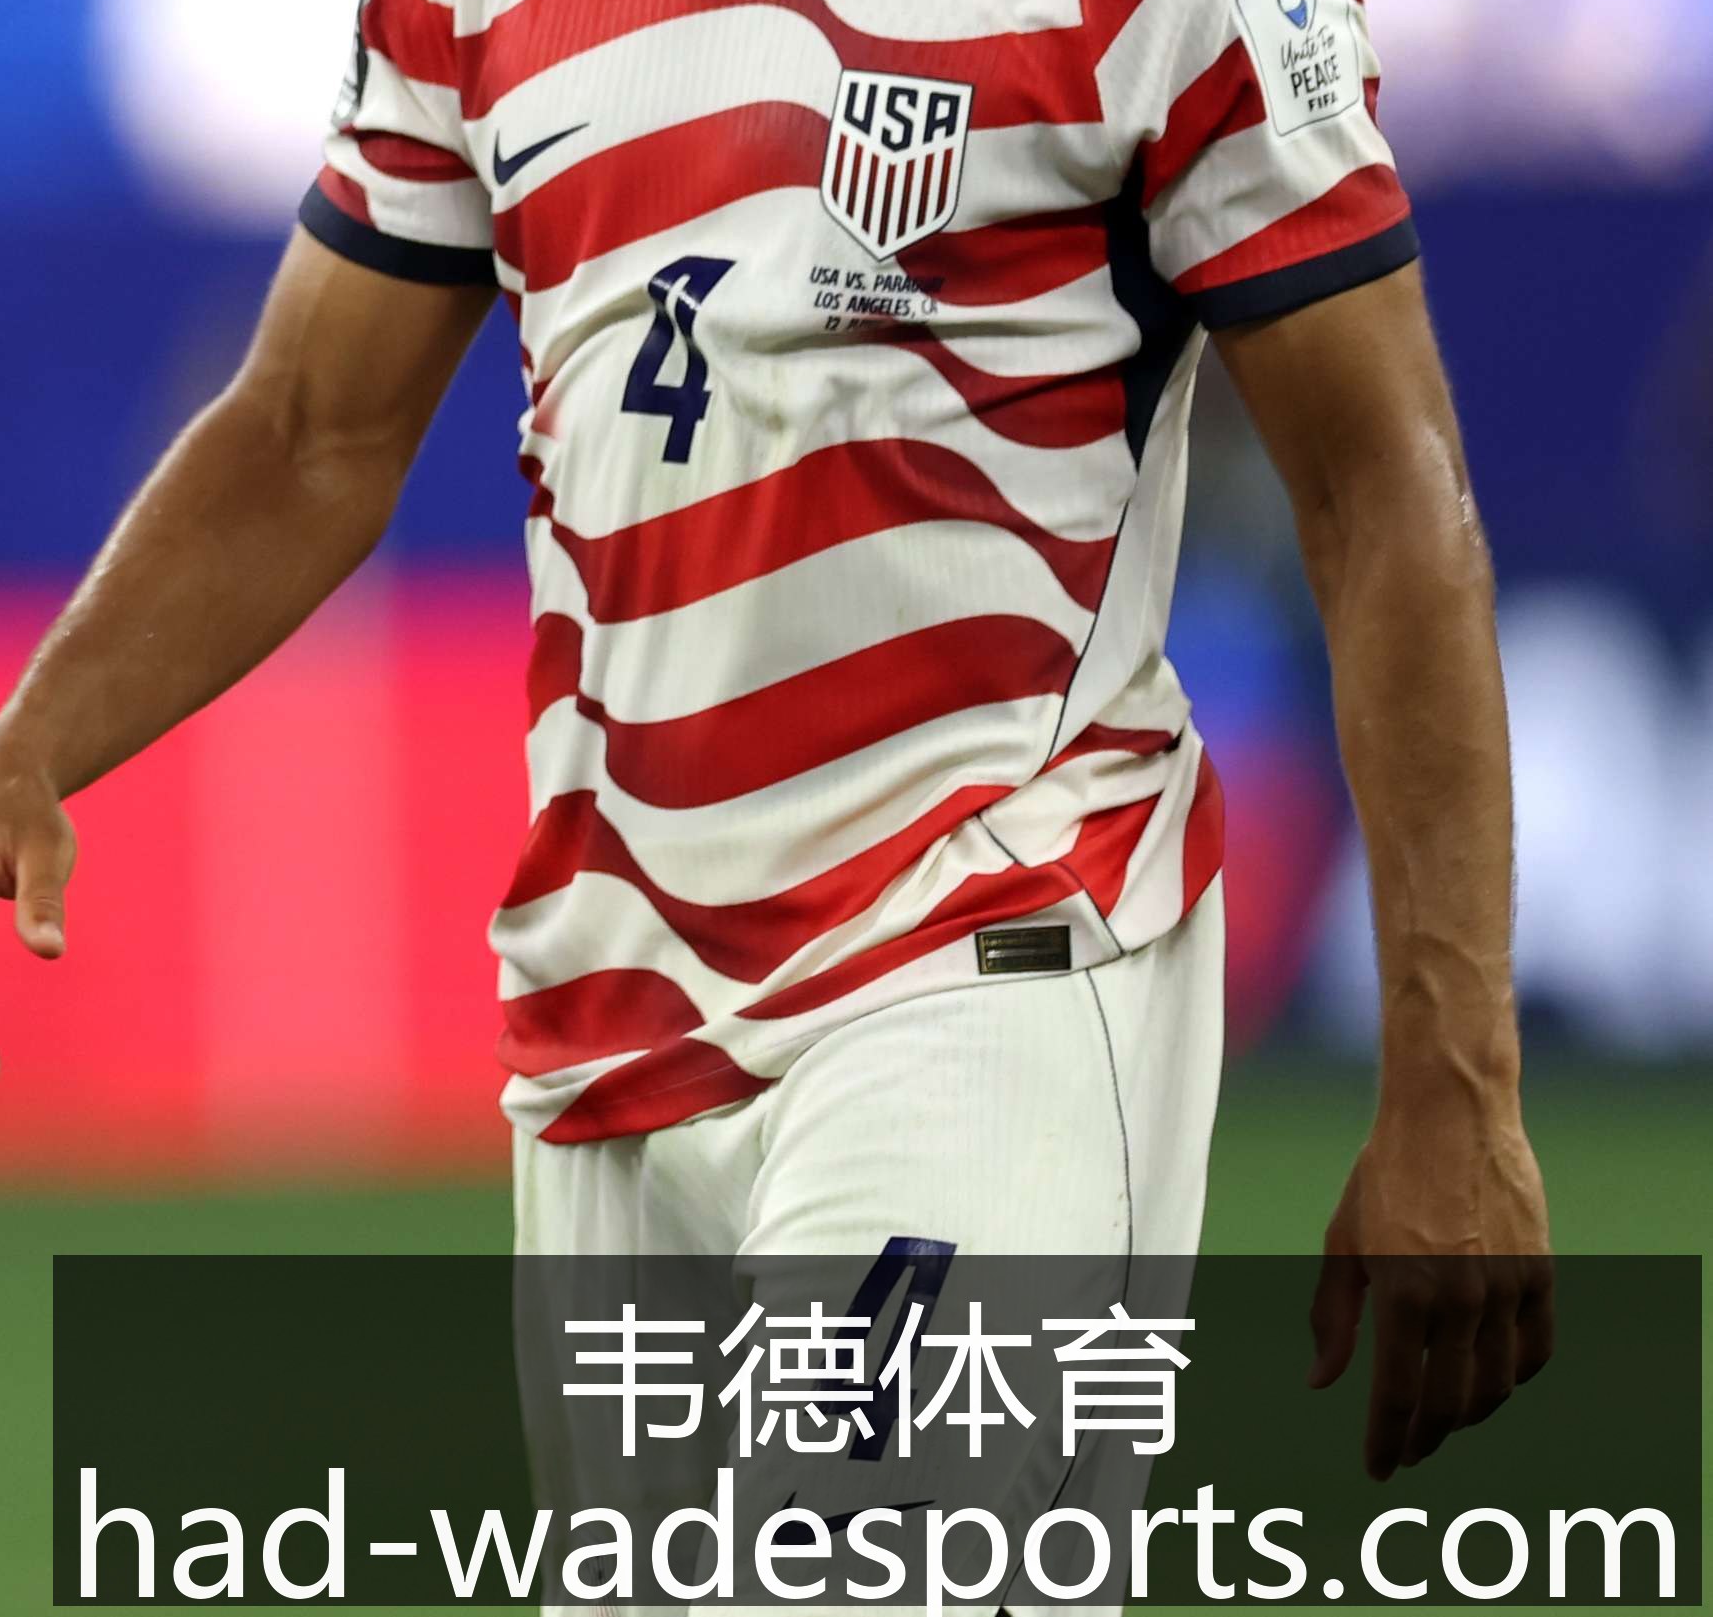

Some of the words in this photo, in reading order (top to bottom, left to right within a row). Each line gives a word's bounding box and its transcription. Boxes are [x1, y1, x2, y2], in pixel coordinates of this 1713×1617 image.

[1290, 53, 1341, 98] PEACE
[843, 81, 961, 153] USA
[810, 265, 840, 286] USA
[846, 271, 865, 290] VS.
[814, 291, 842, 310] LOS
[846, 295, 916, 319] ANGELES,
[825, 315, 841, 331] 12
[620, 256, 737, 464] 4
[803, 1236, 958, 1461] 4
